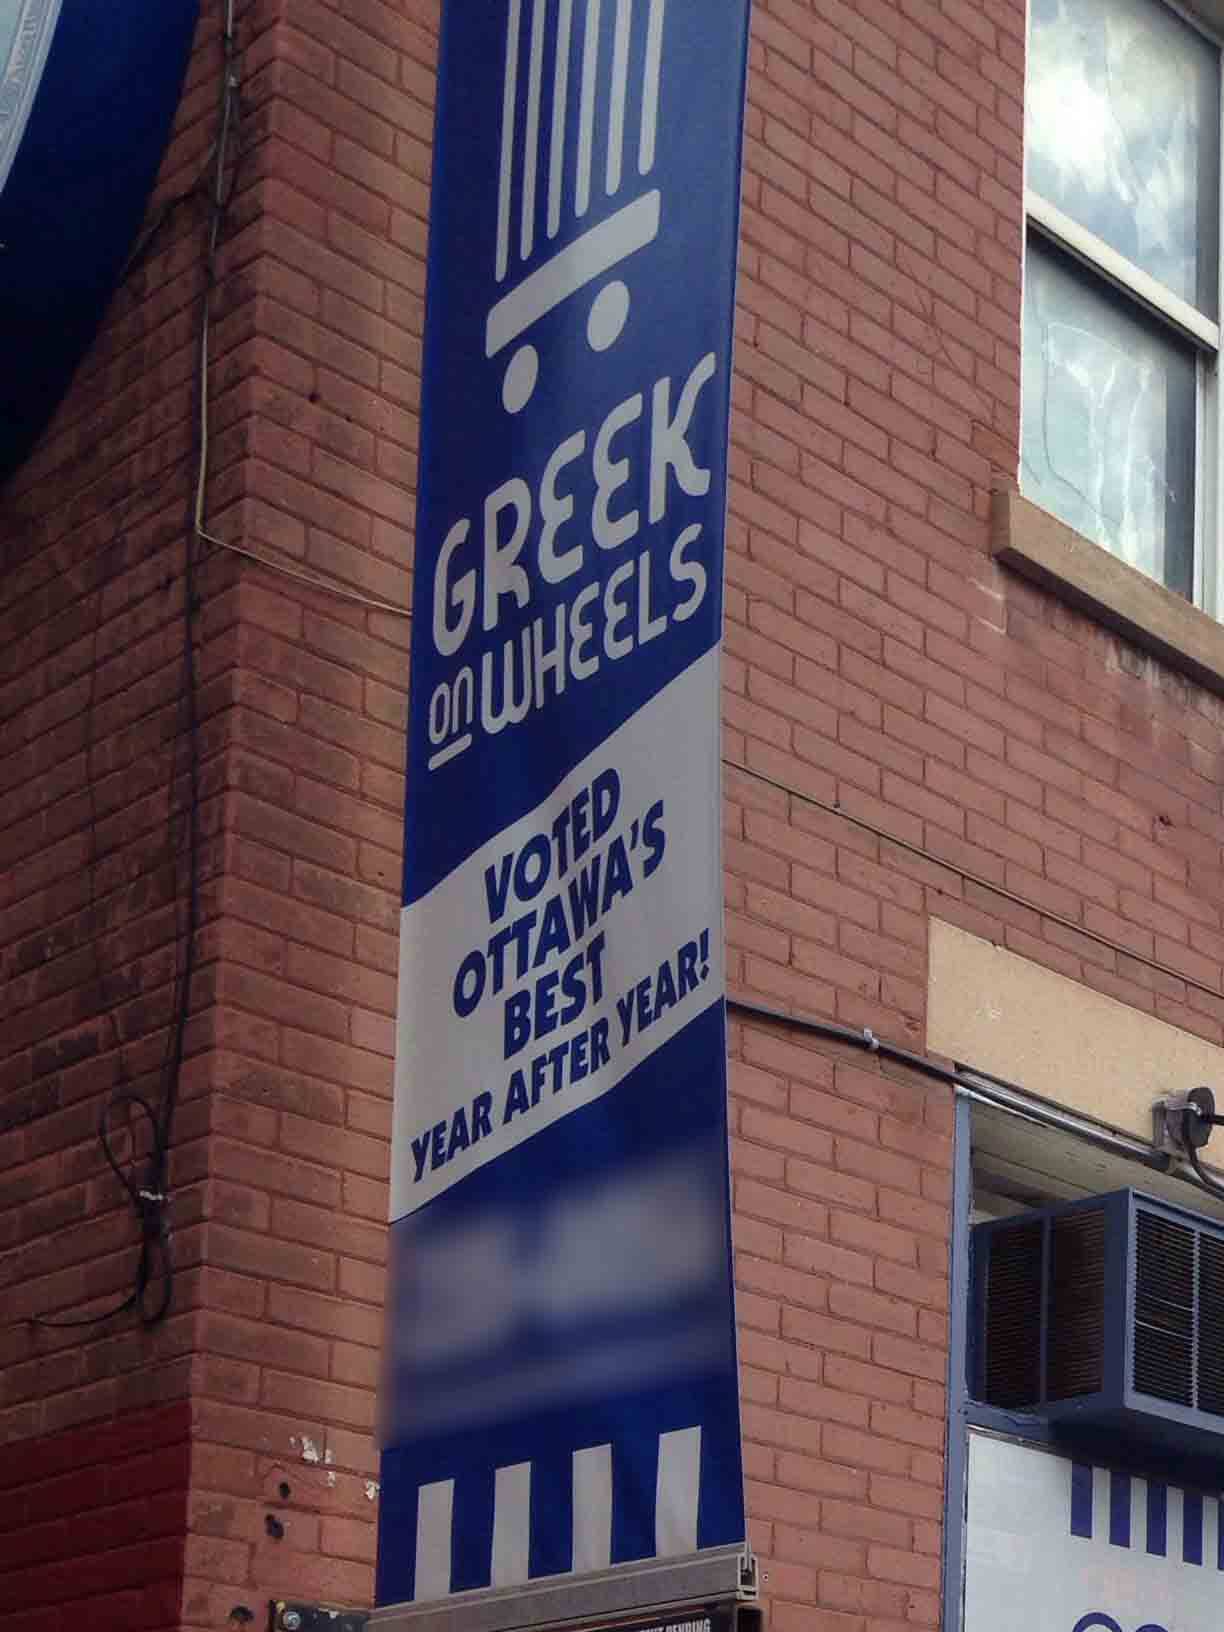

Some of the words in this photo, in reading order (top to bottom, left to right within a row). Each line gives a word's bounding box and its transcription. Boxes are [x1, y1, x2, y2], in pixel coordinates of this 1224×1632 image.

[432, 351, 716, 657] GREEK
[481, 523, 707, 734] WHEELS
[453, 800, 666, 1018] OTTAWA'S
[484, 767, 621, 924] VOTED
[411, 1090, 493, 1183] YEAR
[503, 1018, 610, 1124] AFTER
[616, 927, 709, 1048] YEAR!
[503, 931, 605, 1061] BEST
